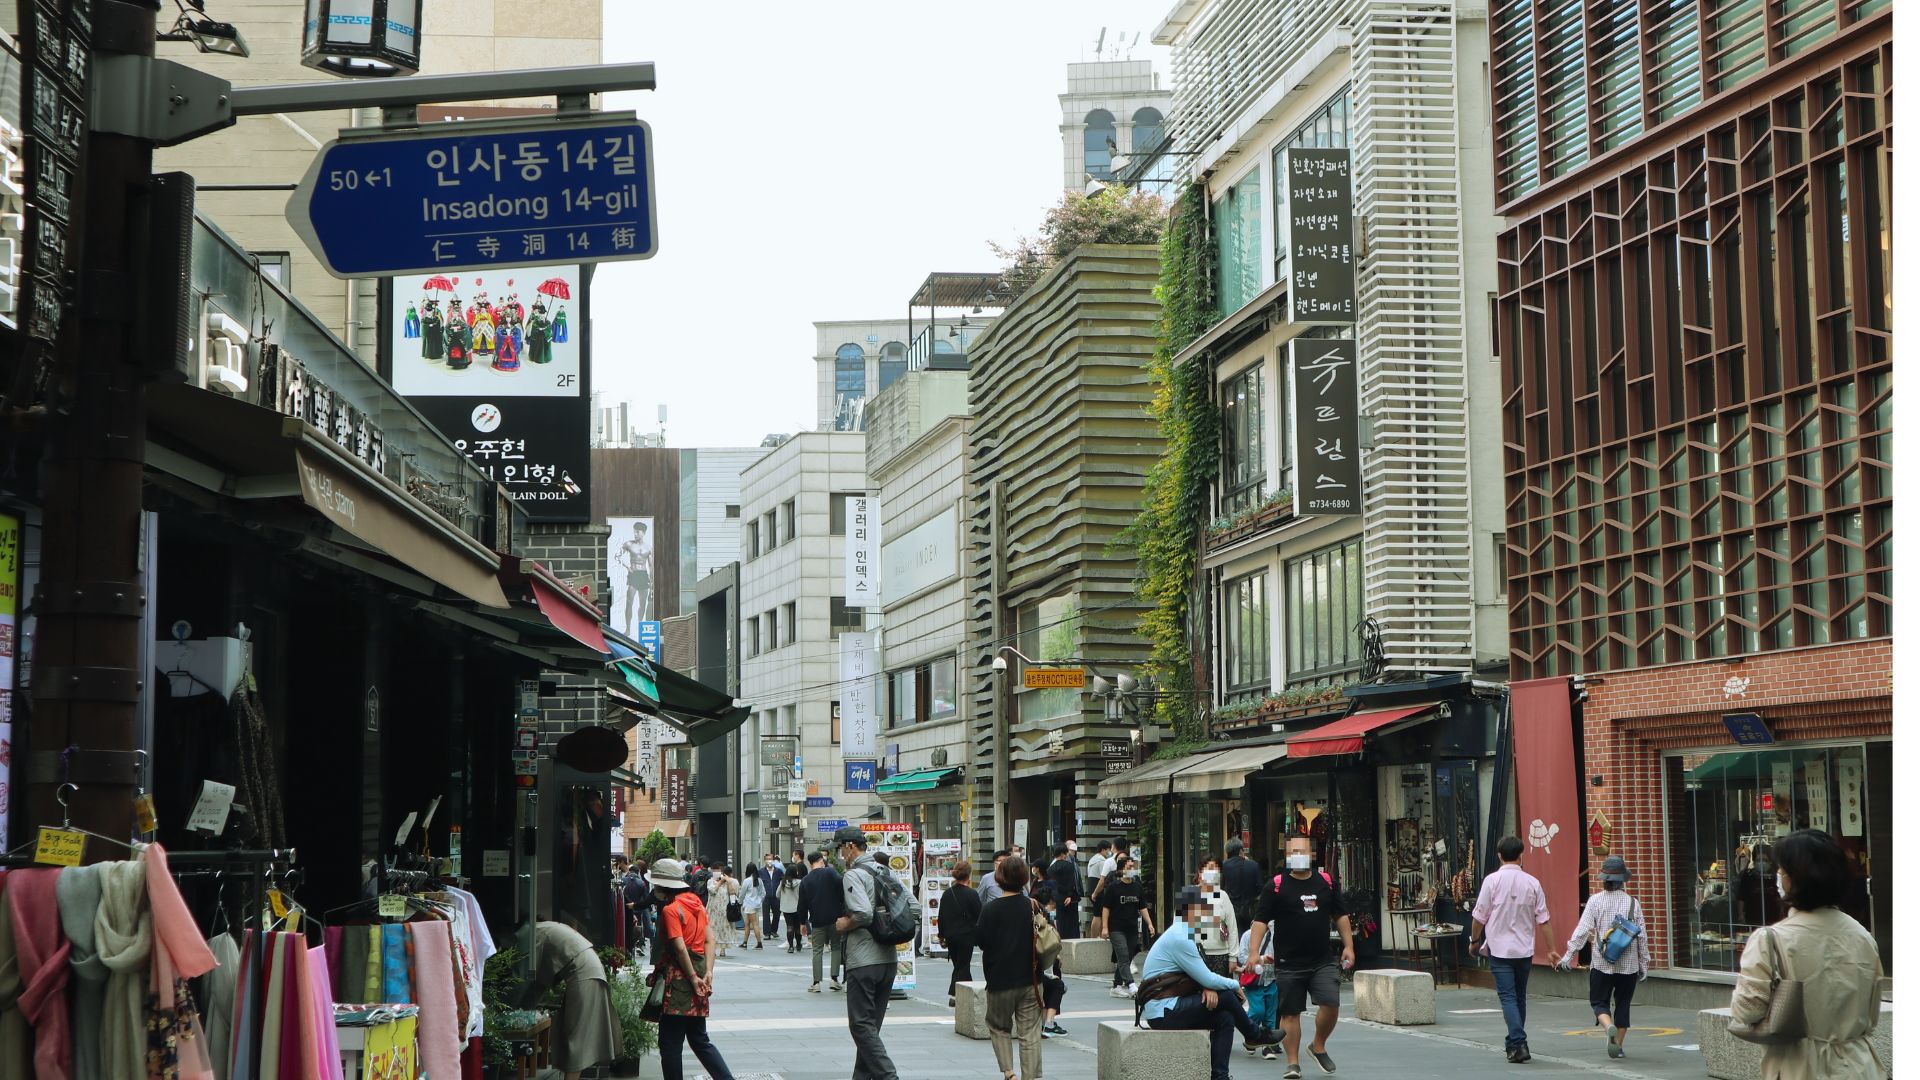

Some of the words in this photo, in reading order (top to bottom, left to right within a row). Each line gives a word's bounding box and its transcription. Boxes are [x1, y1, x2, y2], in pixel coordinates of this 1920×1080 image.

[426, 134, 637, 187] 인사동14길
[330, 169, 359, 191] 50
[382, 167, 392, 188] 1
[423, 194, 548, 222] Insadong
[561, 185, 638, 215] 14-gil
[1294, 214, 1338, 231] 자연염색
[1297, 244, 1350, 264] 오가닉코튼
[1296, 270, 1318, 288] 린넨
[1296, 296, 1350, 315] 핸드메이드
[556, 374, 576, 387] 2F
[504, 464, 556, 486] 인형
[539, 491, 568, 501] DOLL
[1315, 499, 1350, 509] 734-6890
[334, 488, 355, 527] stamp
[855, 498, 867, 542] 갤러리
[916, 543, 938, 568] INDEX
[855, 549, 868, 592] 인덱스
